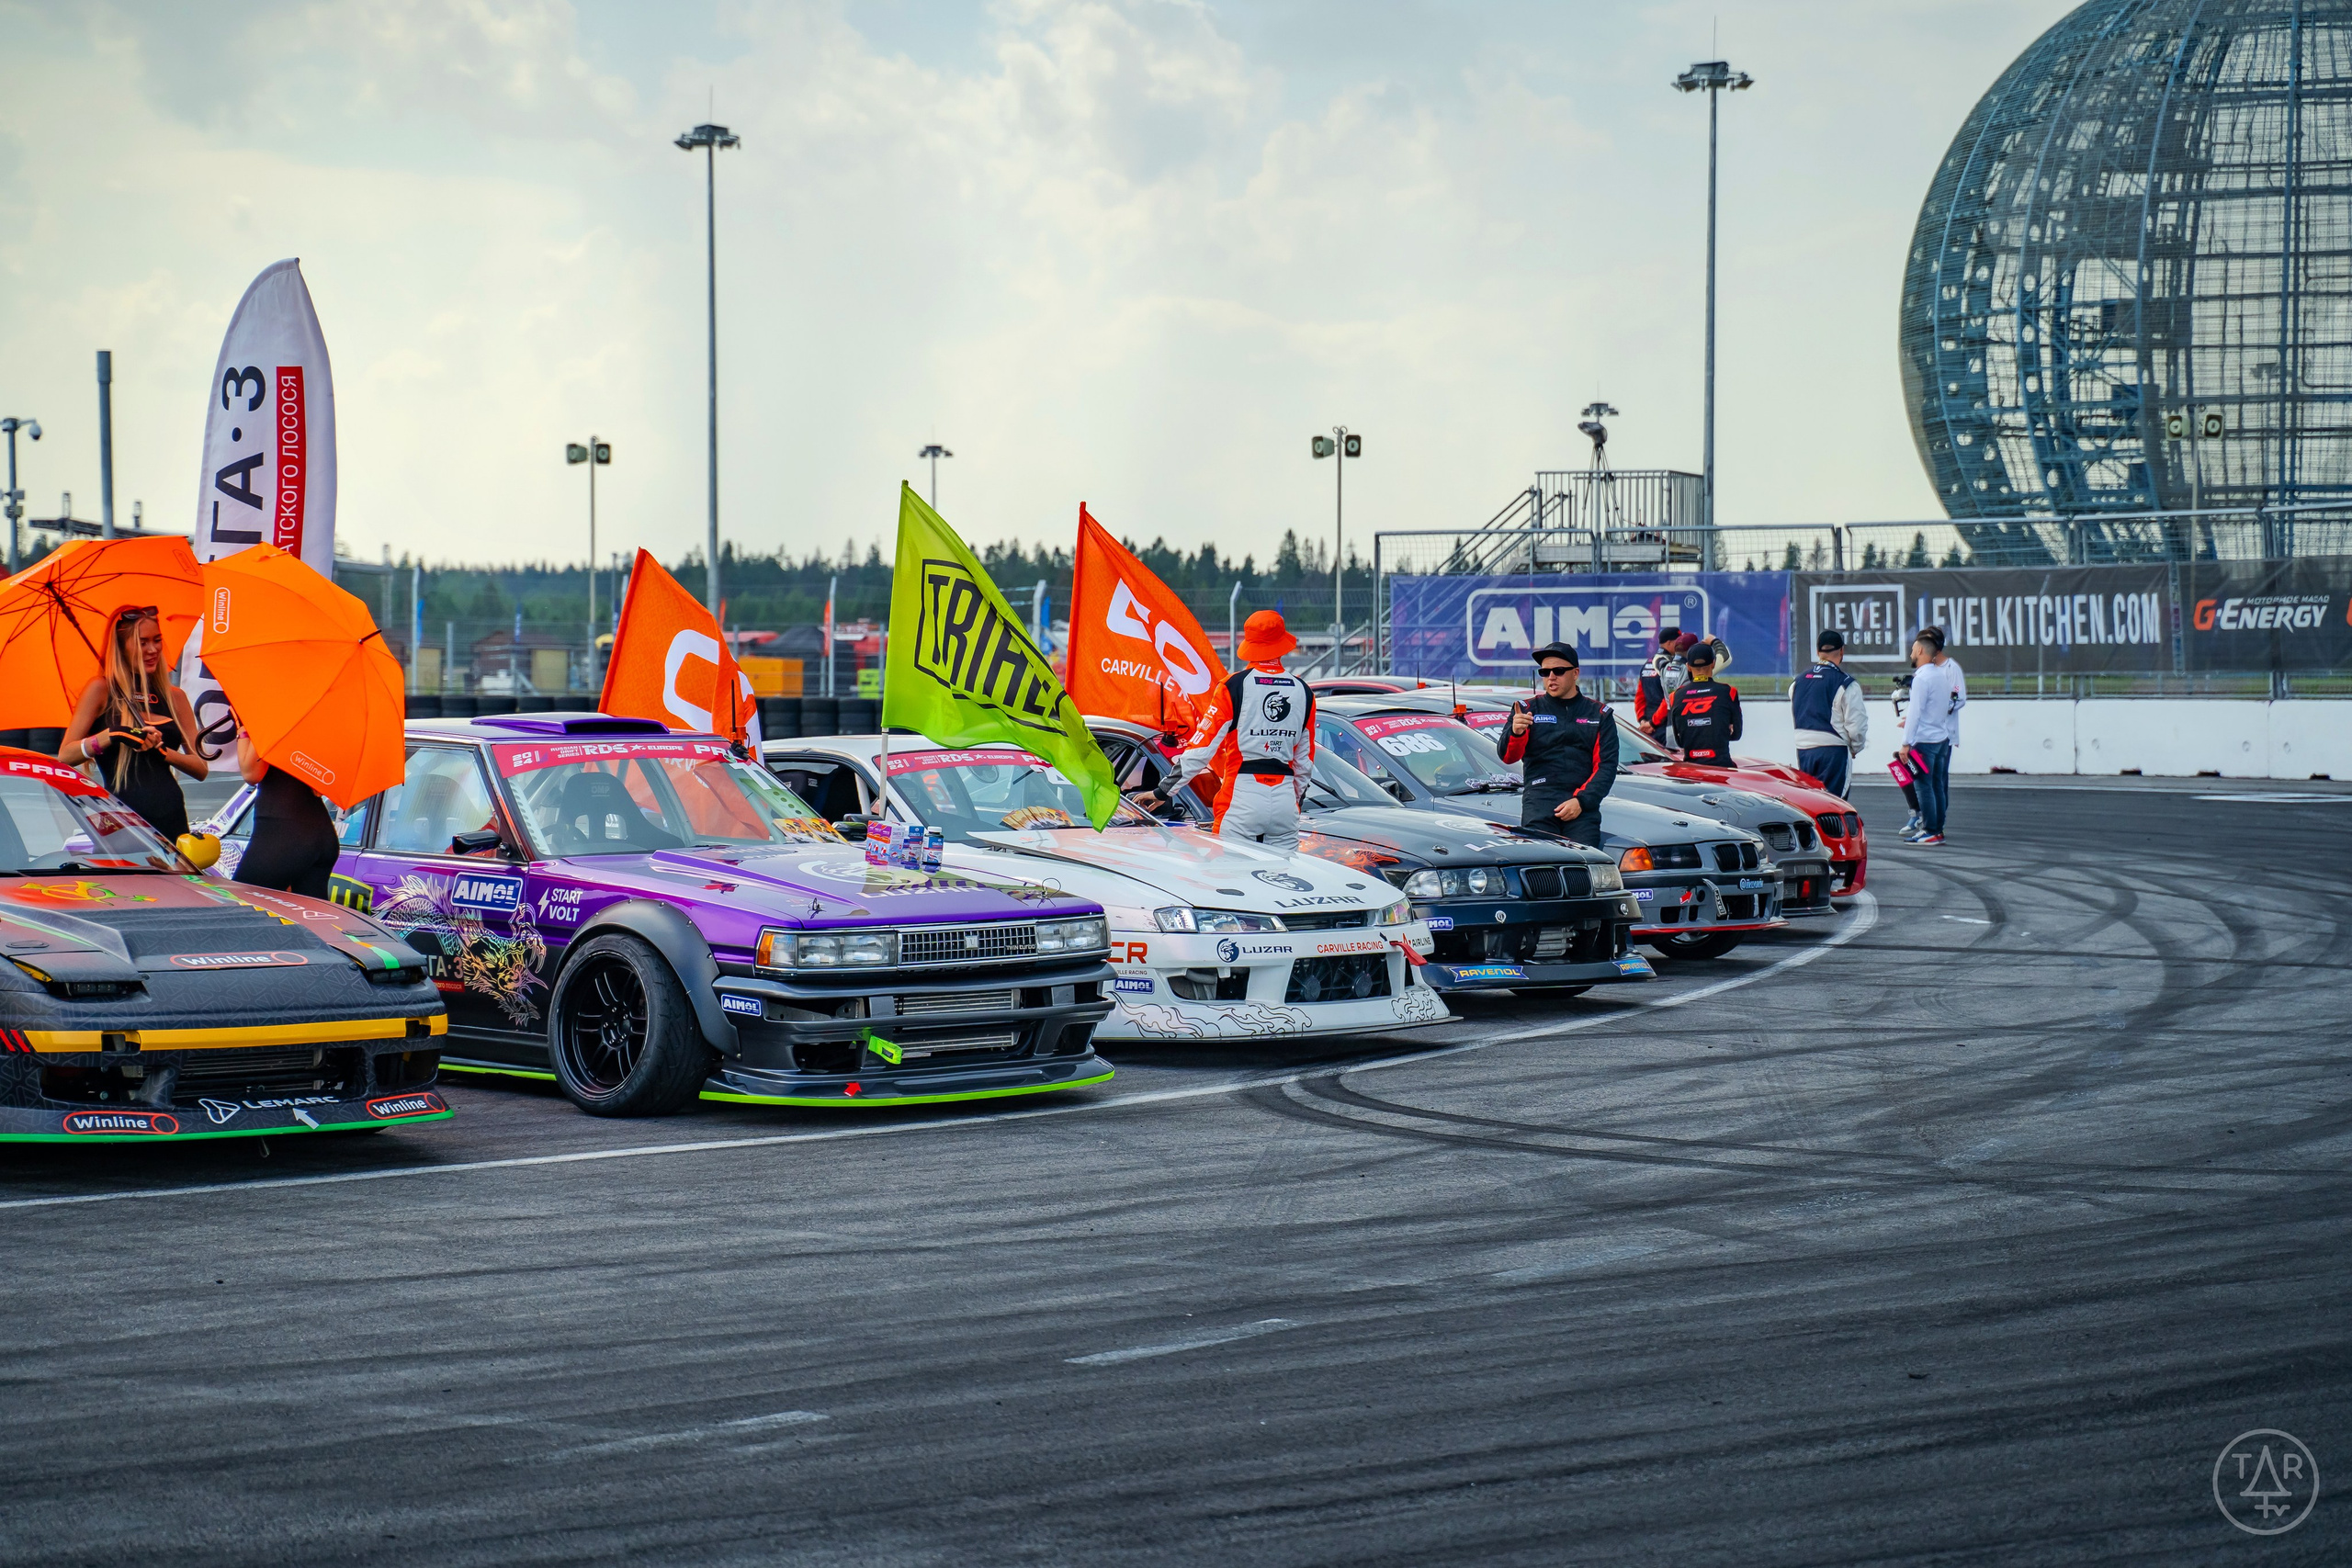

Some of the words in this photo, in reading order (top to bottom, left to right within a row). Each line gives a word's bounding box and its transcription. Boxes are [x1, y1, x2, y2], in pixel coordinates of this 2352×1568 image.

[280, 375, 300, 459] ЛОСОСЯ
[217, 591, 227, 621] Winline
[1842, 630, 1893, 646] TCHEN
[1101, 657, 1176, 693] CARVILLE
[1397, 718, 1422, 727] RDS
[1250, 728, 1297, 738] LUZAR
[582, 743, 628, 756] RDS
[693, 745, 732, 759] PR
[1377, 732, 1447, 757] 686
[512, 751, 533, 761] 20
[513, 758, 533, 768] 24
[937, 753, 975, 763] RDS
[8, 761, 77, 780] PRO
[294, 754, 322, 777] Winline
[453, 880, 517, 906] AIMOL
[551, 887, 583, 905] START
[855, 886, 986, 899] LUZAR
[1273, 896, 1365, 908] LUZAR
[549, 905, 581, 922] VOLT
[1242, 945, 1294, 953] LUZAR
[1317, 942, 1356, 953] CARVILLE
[1357, 940, 1385, 951] RACING
[1411, 936, 1432, 947] AIRLINE
[180, 953, 272, 966] Winline
[1459, 967, 1521, 977] RAVENOL
[1115, 979, 1152, 991] AIMOL
[723, 998, 759, 1013] AIMOL
[242, 1095, 340, 1110] LEMARC
[372, 1097, 428, 1116] Winline
[73, 1116, 149, 1130] Winline
